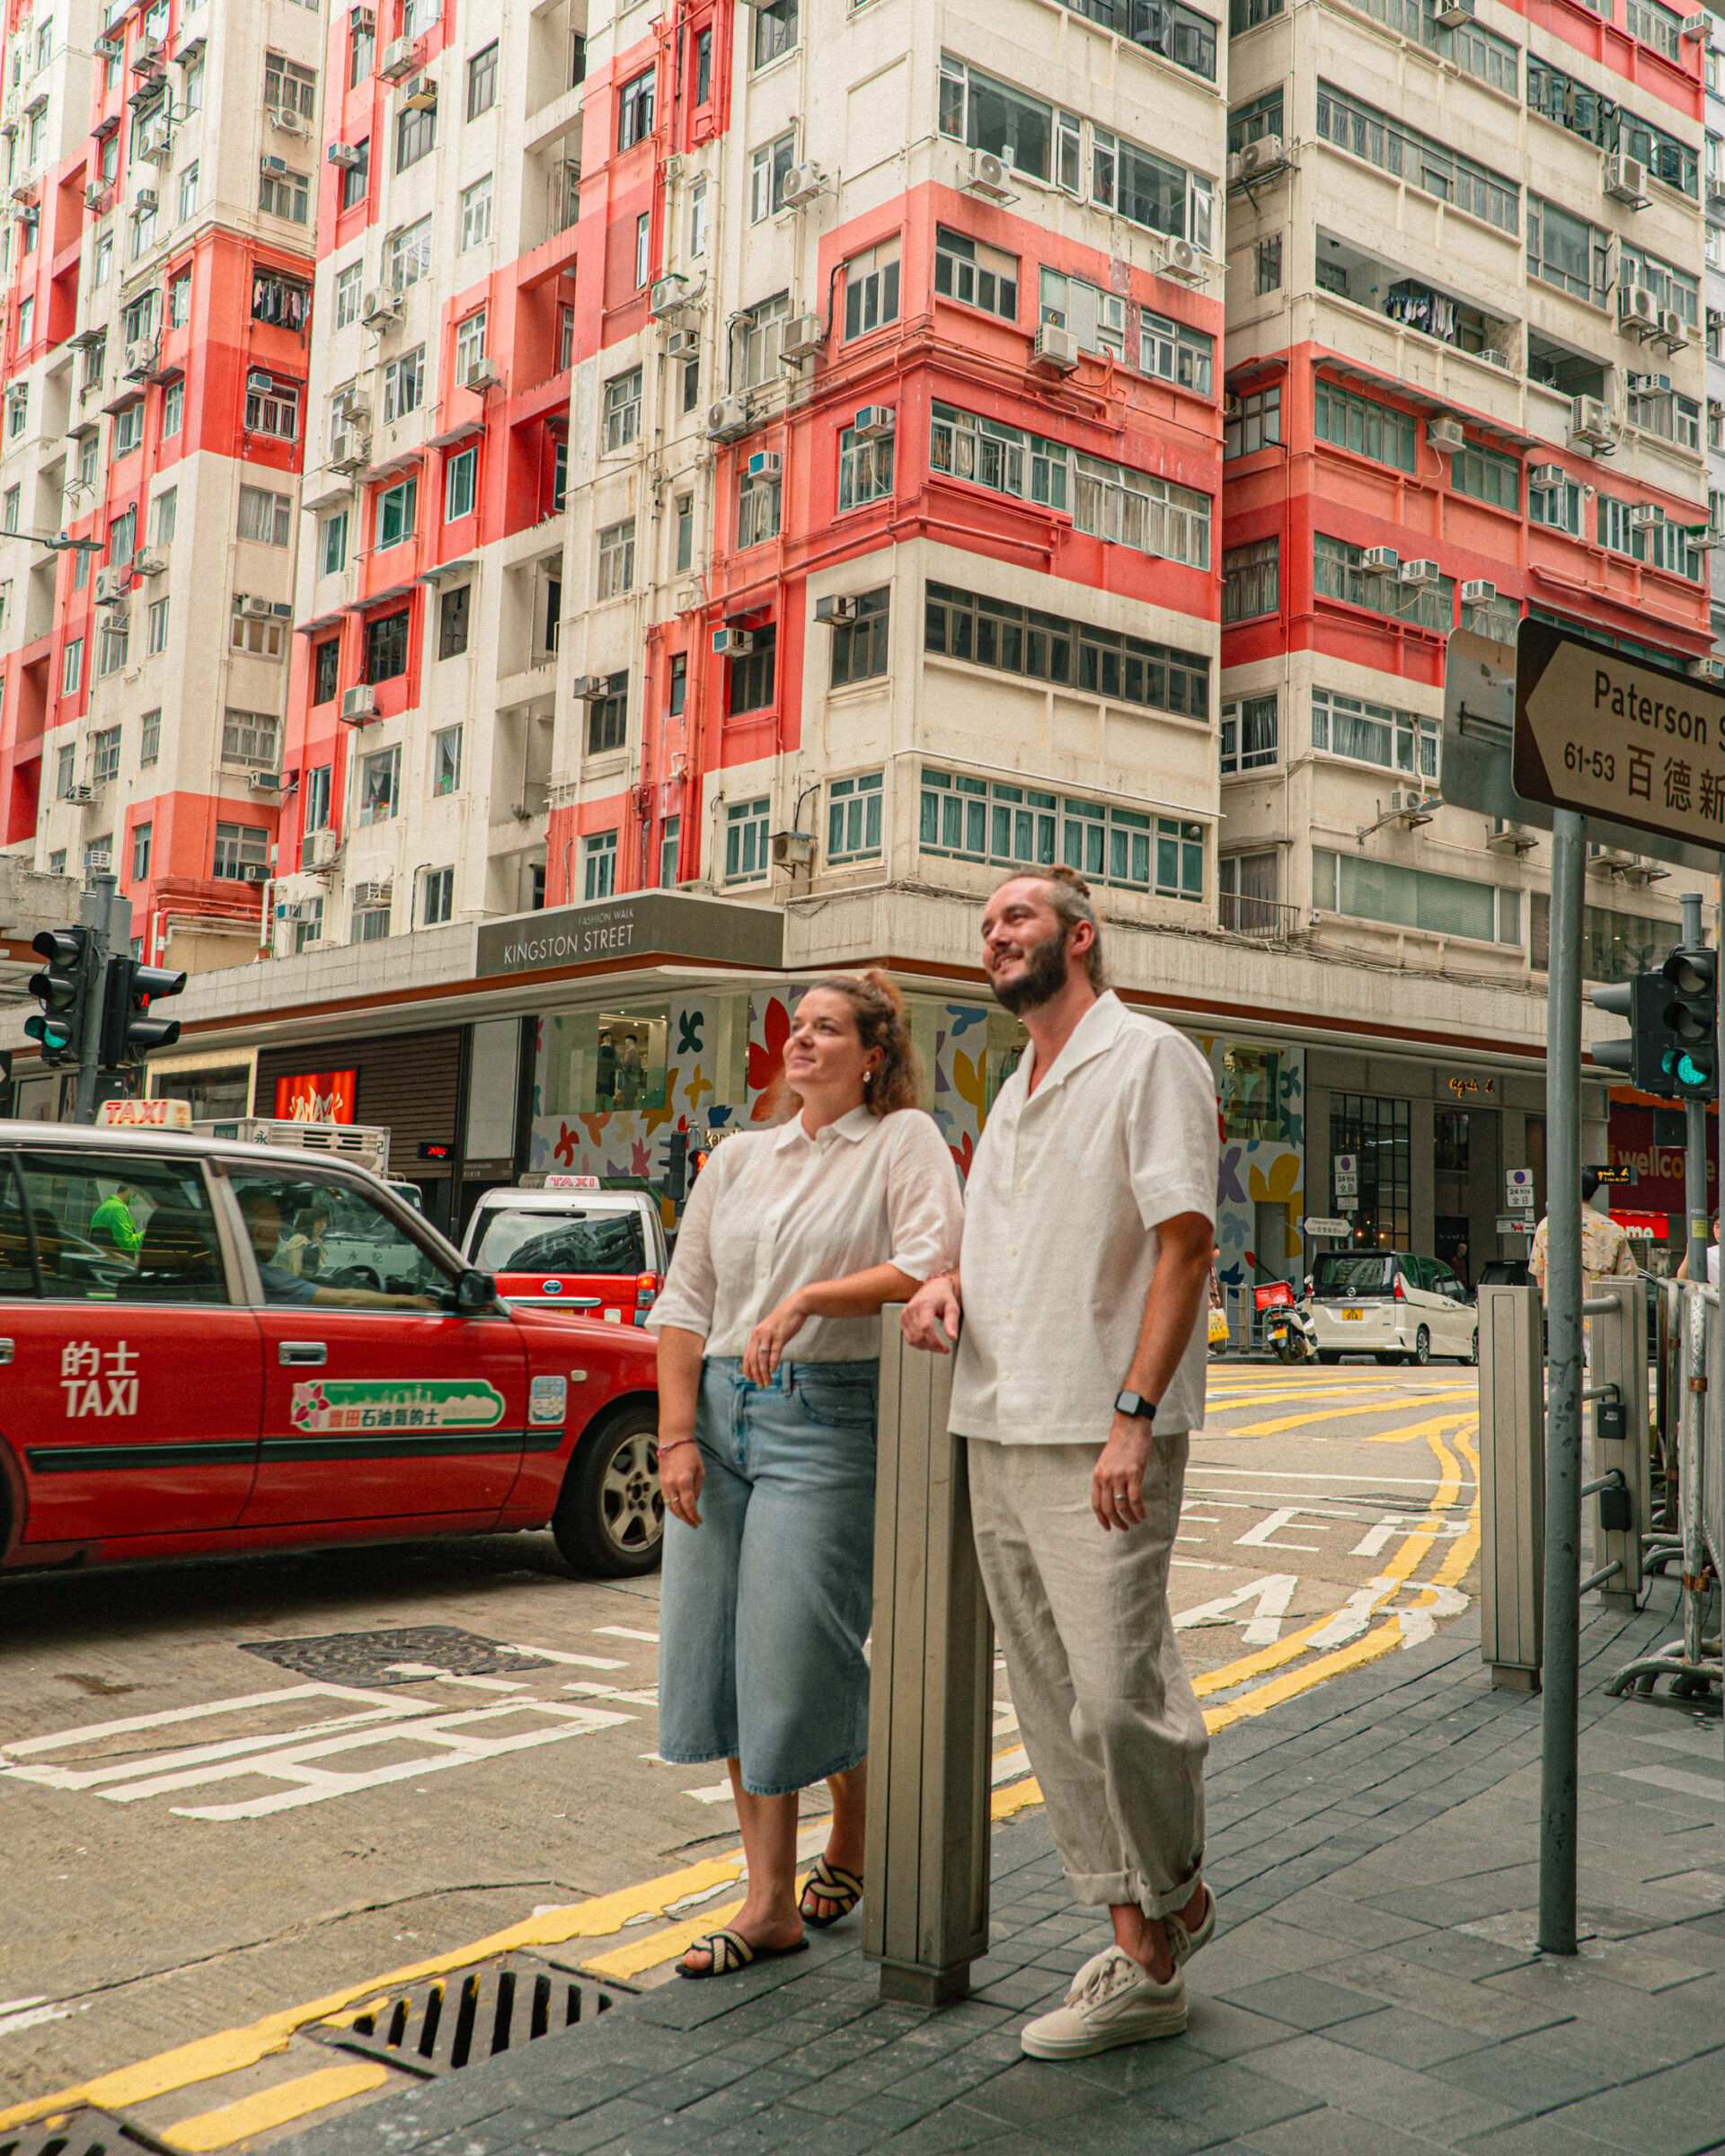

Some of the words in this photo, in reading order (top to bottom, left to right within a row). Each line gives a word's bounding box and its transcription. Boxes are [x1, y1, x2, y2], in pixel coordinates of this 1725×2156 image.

[1594, 669, 1707, 745] Paterson
[1564, 741, 1615, 782] 61-53
[578, 910, 611, 927] FASHION
[614, 907, 634, 921] WALK
[503, 934, 578, 965] KINGSTON
[585, 923, 634, 952] STREET
[106, 1100, 168, 1125] TAXI
[254, 1129, 269, 1144] 永
[1618, 1145, 1717, 1182] wellcoe
[550, 1177, 595, 1188] TAXI
[60, 1340, 140, 1377] 的士
[59, 1379, 139, 1418] TAXI
[1175, 1500, 1472, 1557] EEP
